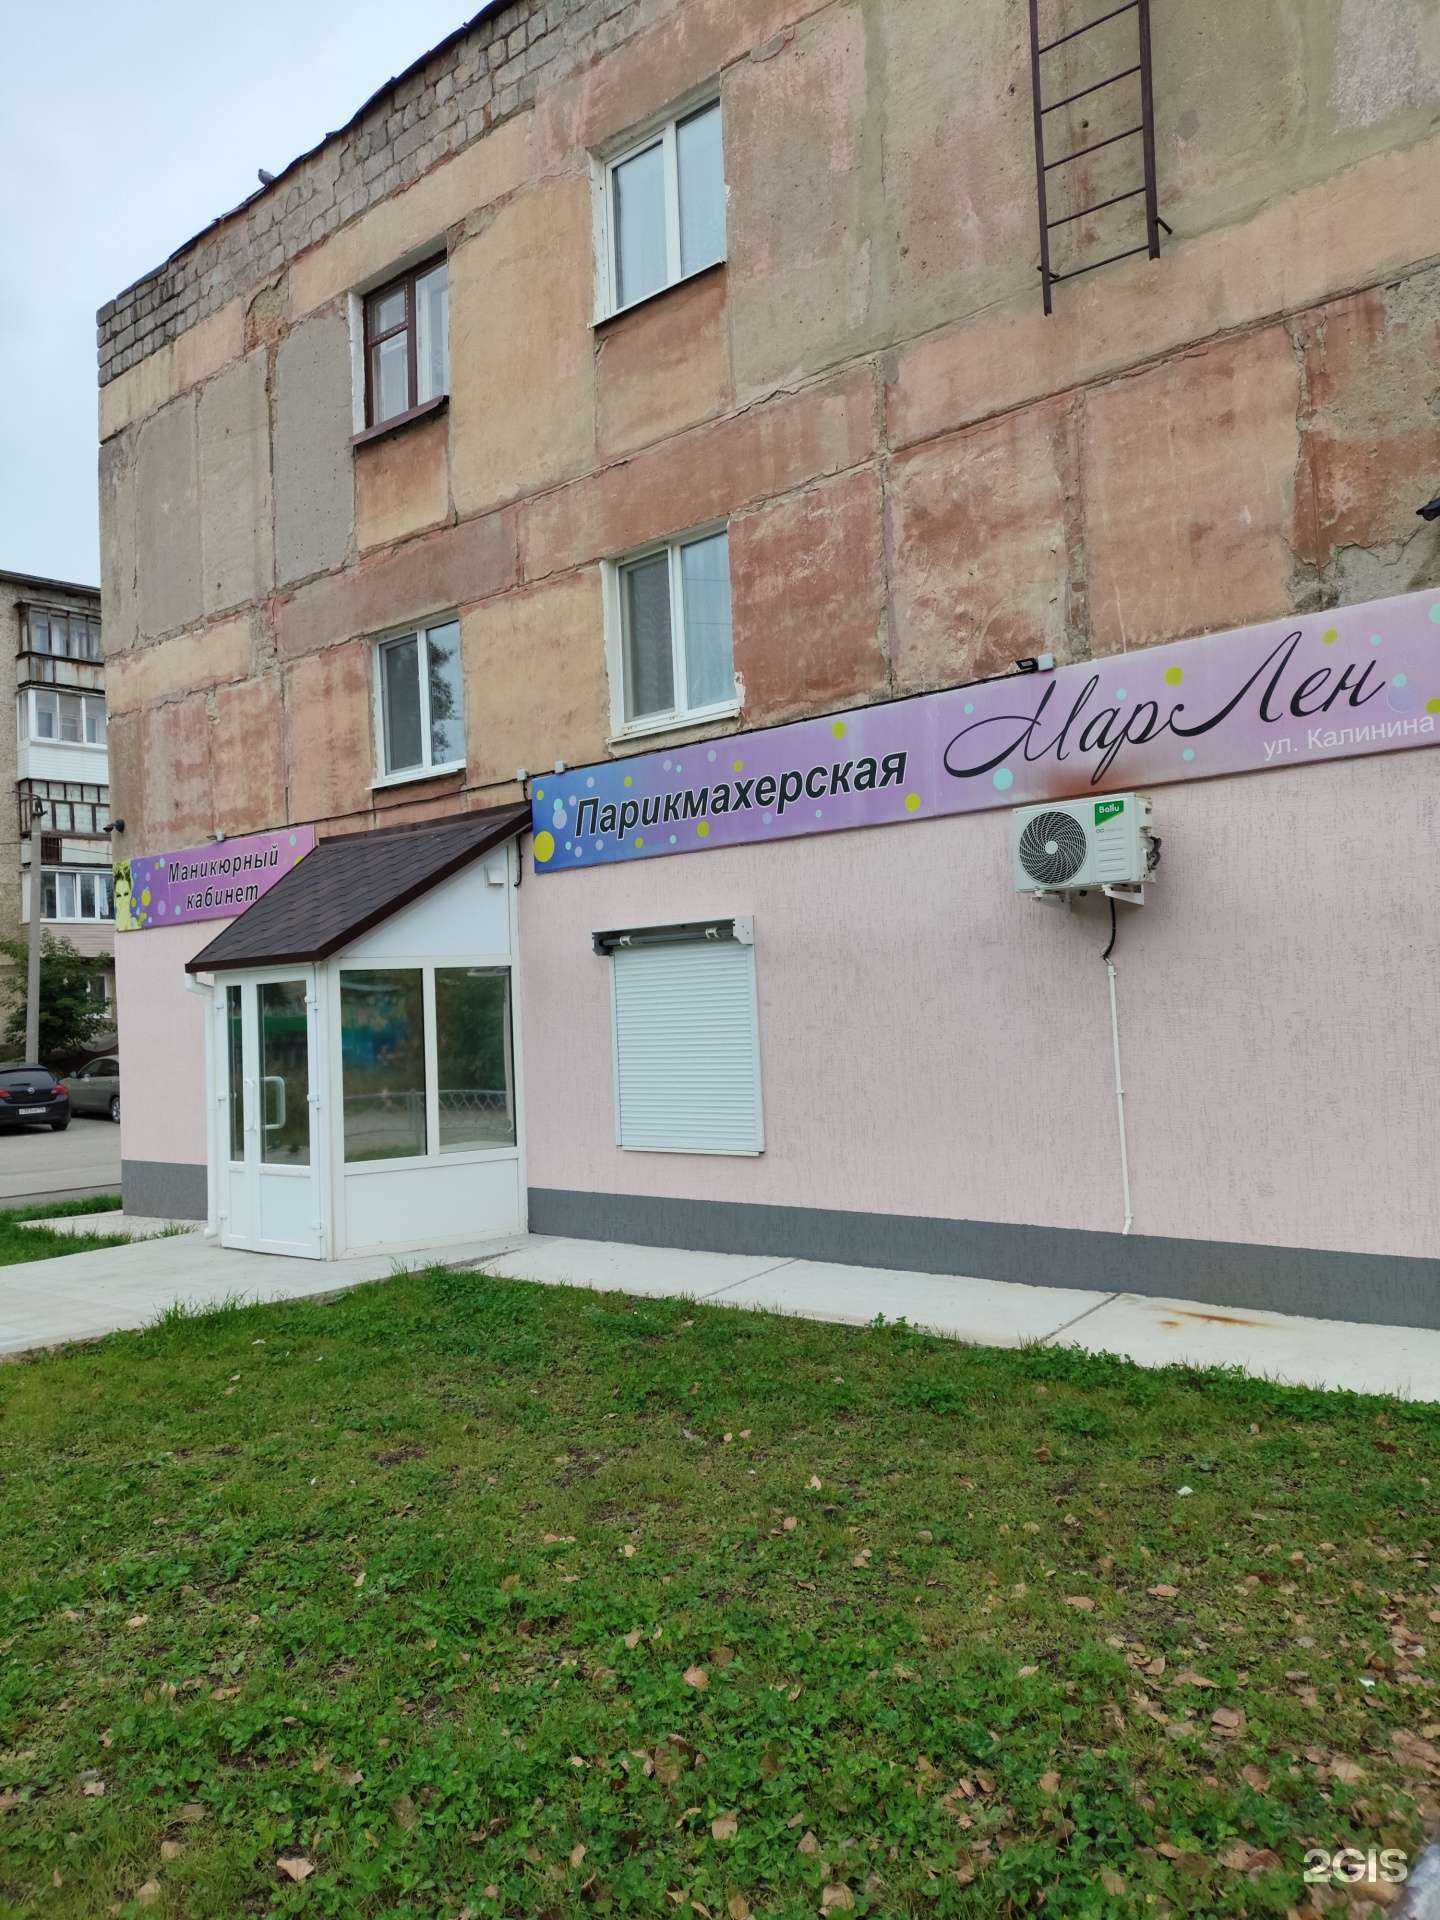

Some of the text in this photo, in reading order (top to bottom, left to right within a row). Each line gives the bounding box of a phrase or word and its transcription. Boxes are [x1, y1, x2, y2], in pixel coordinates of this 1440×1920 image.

[1263, 715, 1435, 761] ул. Калинина
[575, 751, 908, 839] Парикмахерская
[1098, 803, 1120, 814] Ballu
[168, 843, 279, 883] Маникюрный
[186, 884, 260, 910] кабинет
